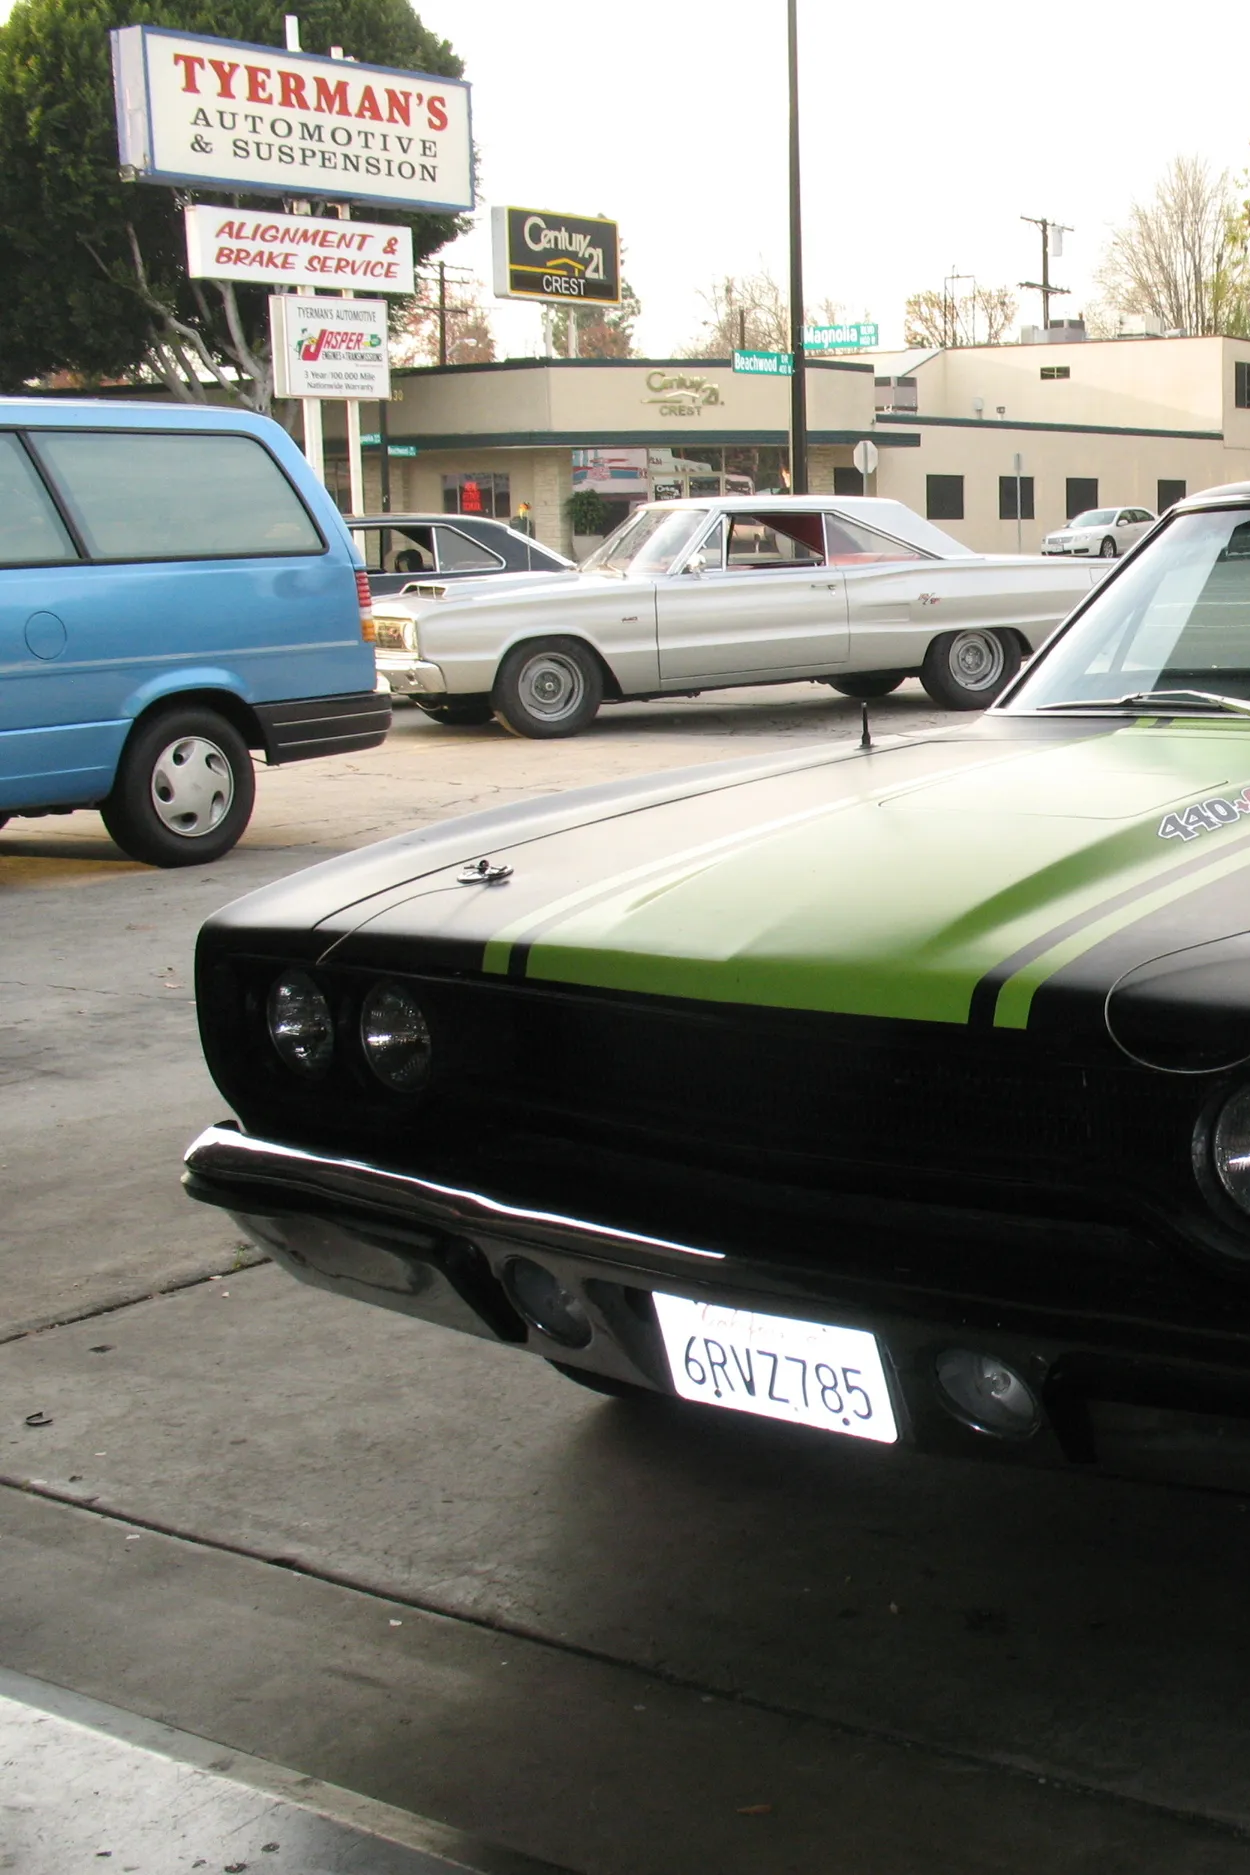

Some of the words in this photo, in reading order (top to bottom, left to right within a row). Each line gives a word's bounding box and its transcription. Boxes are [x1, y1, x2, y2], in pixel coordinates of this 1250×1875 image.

[173, 53, 448, 131] TYERMAN'S
[190, 107, 437, 158] AUTOMOTIVE
[190, 134, 213, 154] &
[232, 138, 438, 182] SUSPENSION
[215, 220, 374, 251] ALIGNMENT
[382, 236, 399, 255] &
[524, 216, 591, 257] Century
[584, 246, 604, 279] 21
[215, 247, 298, 270] BRAKE
[304, 255, 400, 278] SERVICE
[543, 275, 585, 296] CREST
[297, 306, 334, 320] TYERMAN'S
[336, 309, 376, 322] AUTOMOTIVE
[302, 328, 364, 361] JASPER
[804, 327, 858, 348] Magnolia
[734, 352, 778, 372] Beachwood
[307, 382, 343, 390] Nationwide
[344, 383, 374, 392] Warranty
[360, 372, 376, 380] Mile
[646, 370, 707, 392] Century
[659, 405, 702, 417] CREST
[684, 1335, 873, 1420] 6RVZ785
